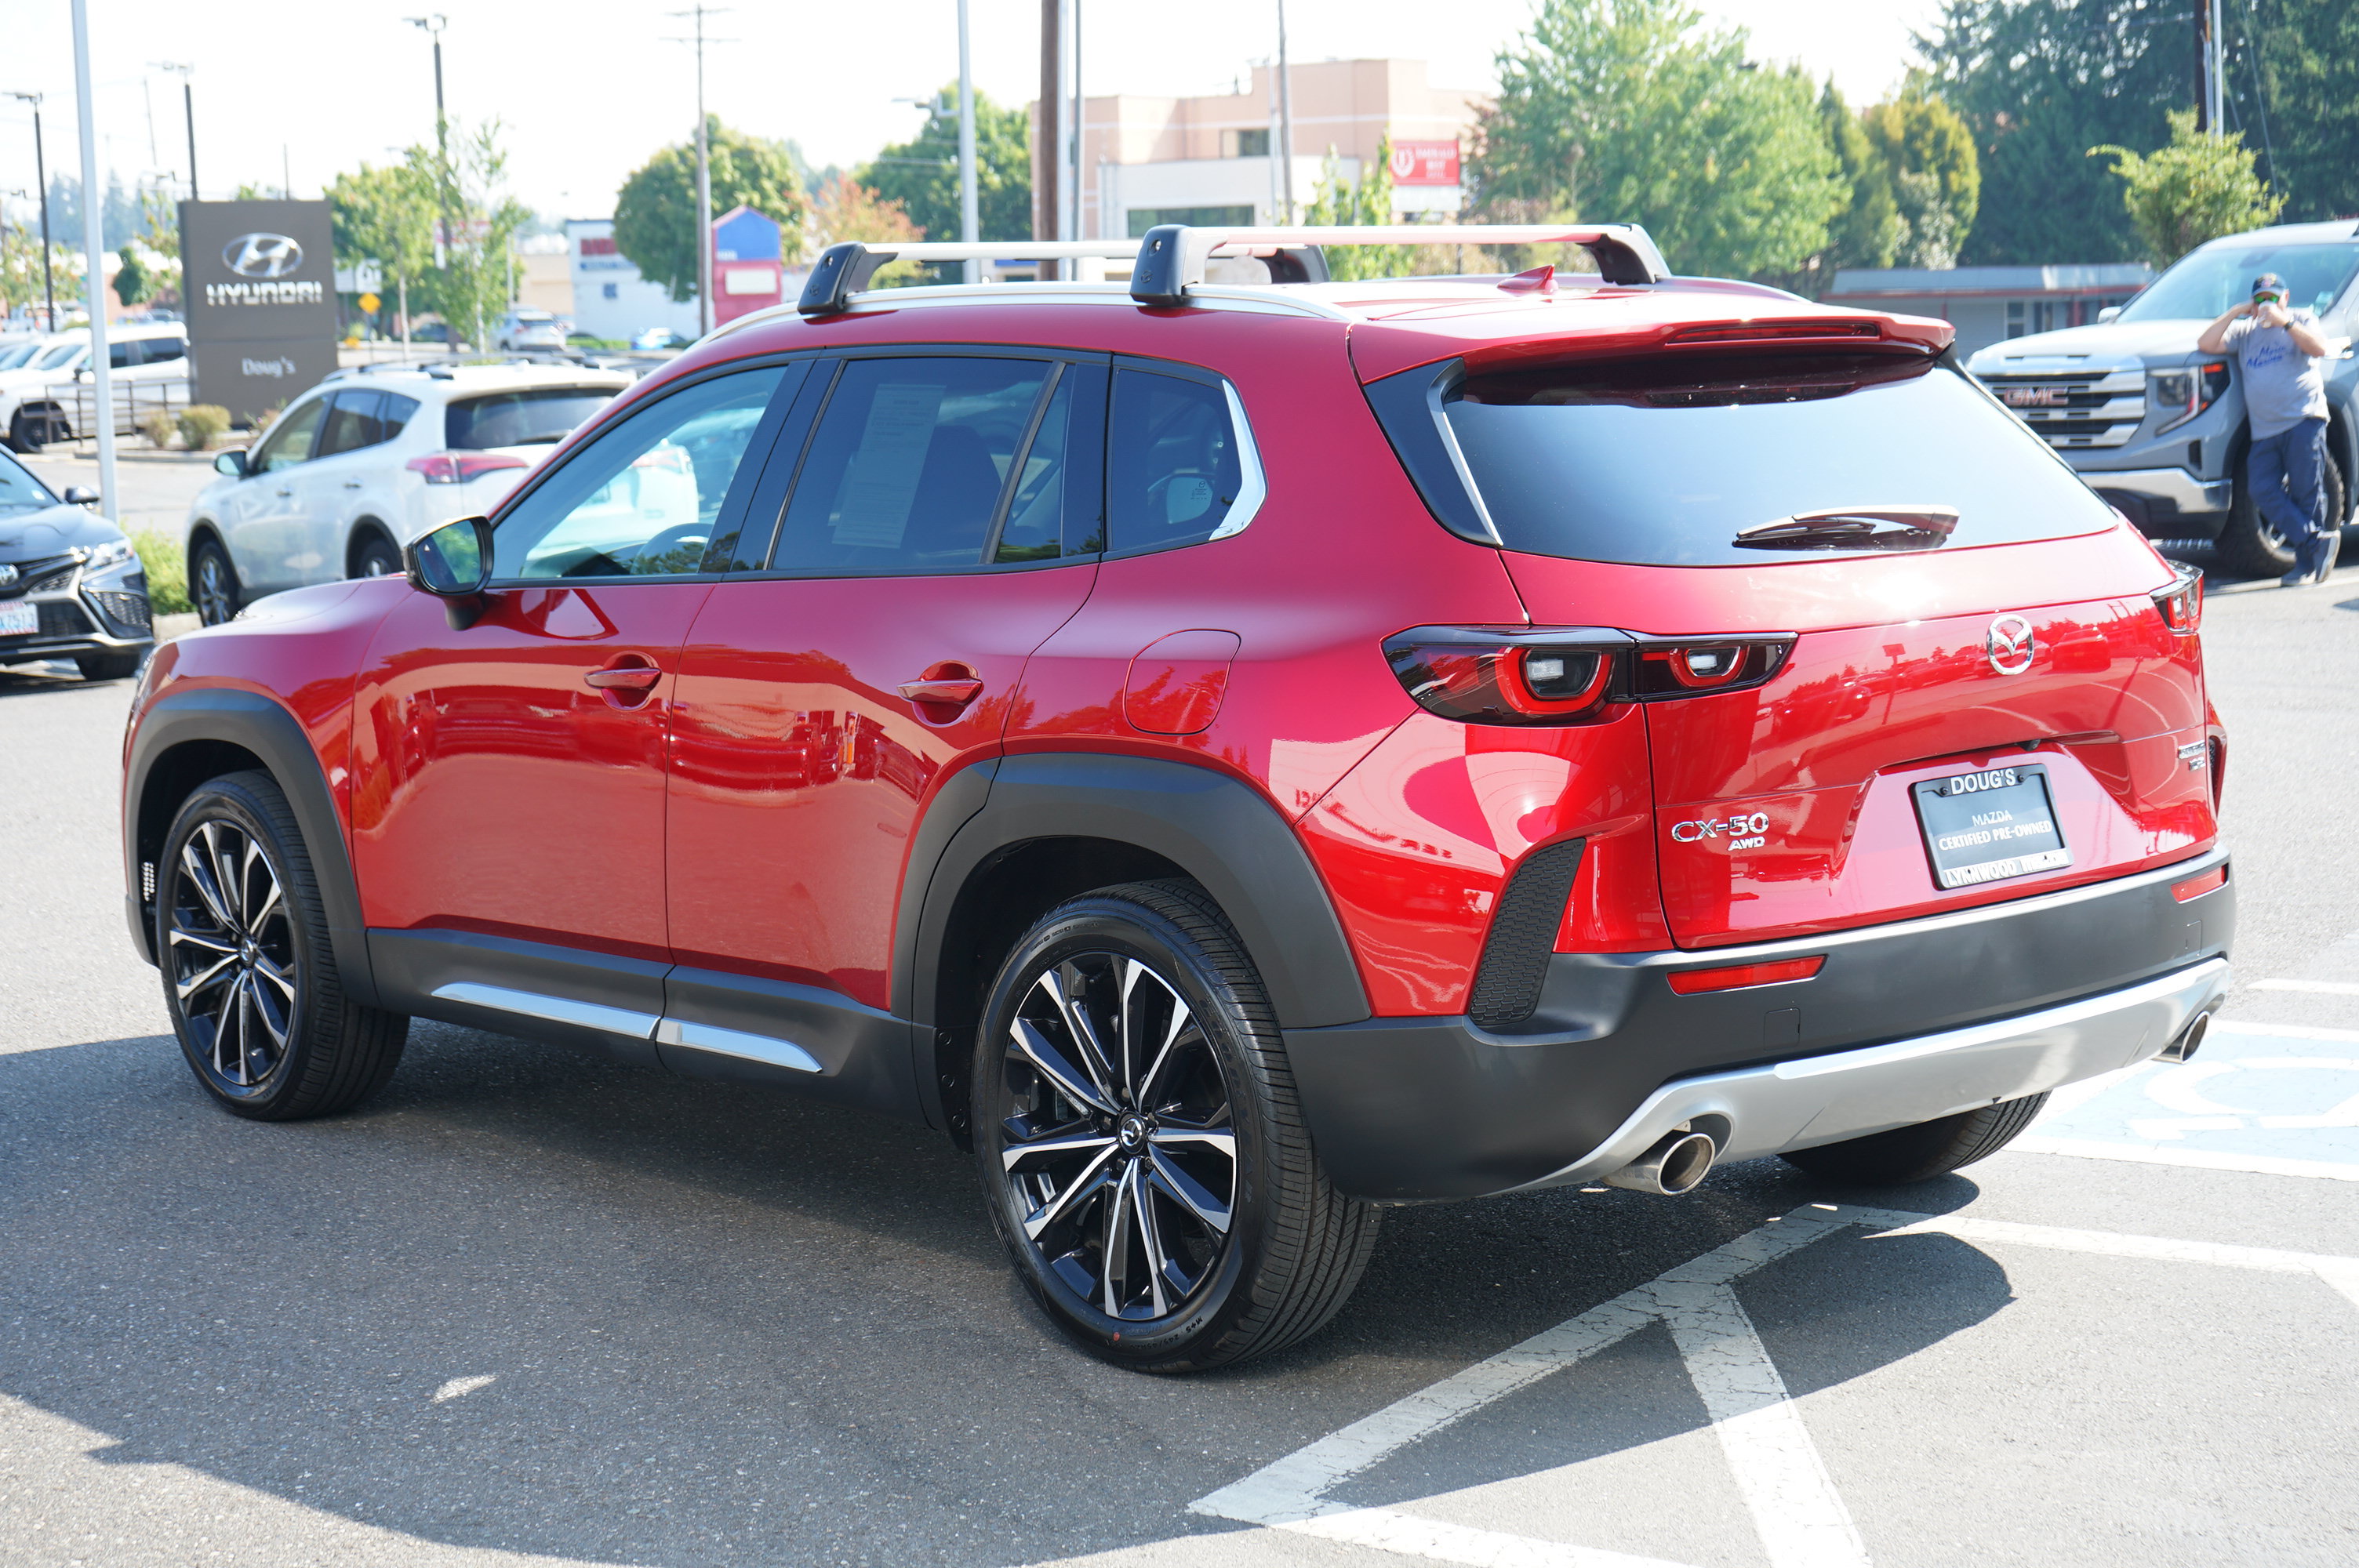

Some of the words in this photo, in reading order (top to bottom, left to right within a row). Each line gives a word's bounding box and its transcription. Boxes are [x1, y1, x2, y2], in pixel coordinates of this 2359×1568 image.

[206, 281, 322, 307] HYUNDAI
[242, 355, 296, 379] Doug's
[2004, 386, 2069, 406] GMC
[1950, 768, 2016, 795] DOUG'S
[1671, 812, 1769, 843] CX-50
[1972, 809, 2013, 826] MAZDA
[1728, 836, 1765, 851] AWD
[1939, 830, 1991, 851] CERTIFIED
[1993, 820, 2053, 841] PRE-OWNED
[1946, 859, 2017, 887] LYNNWOOD
